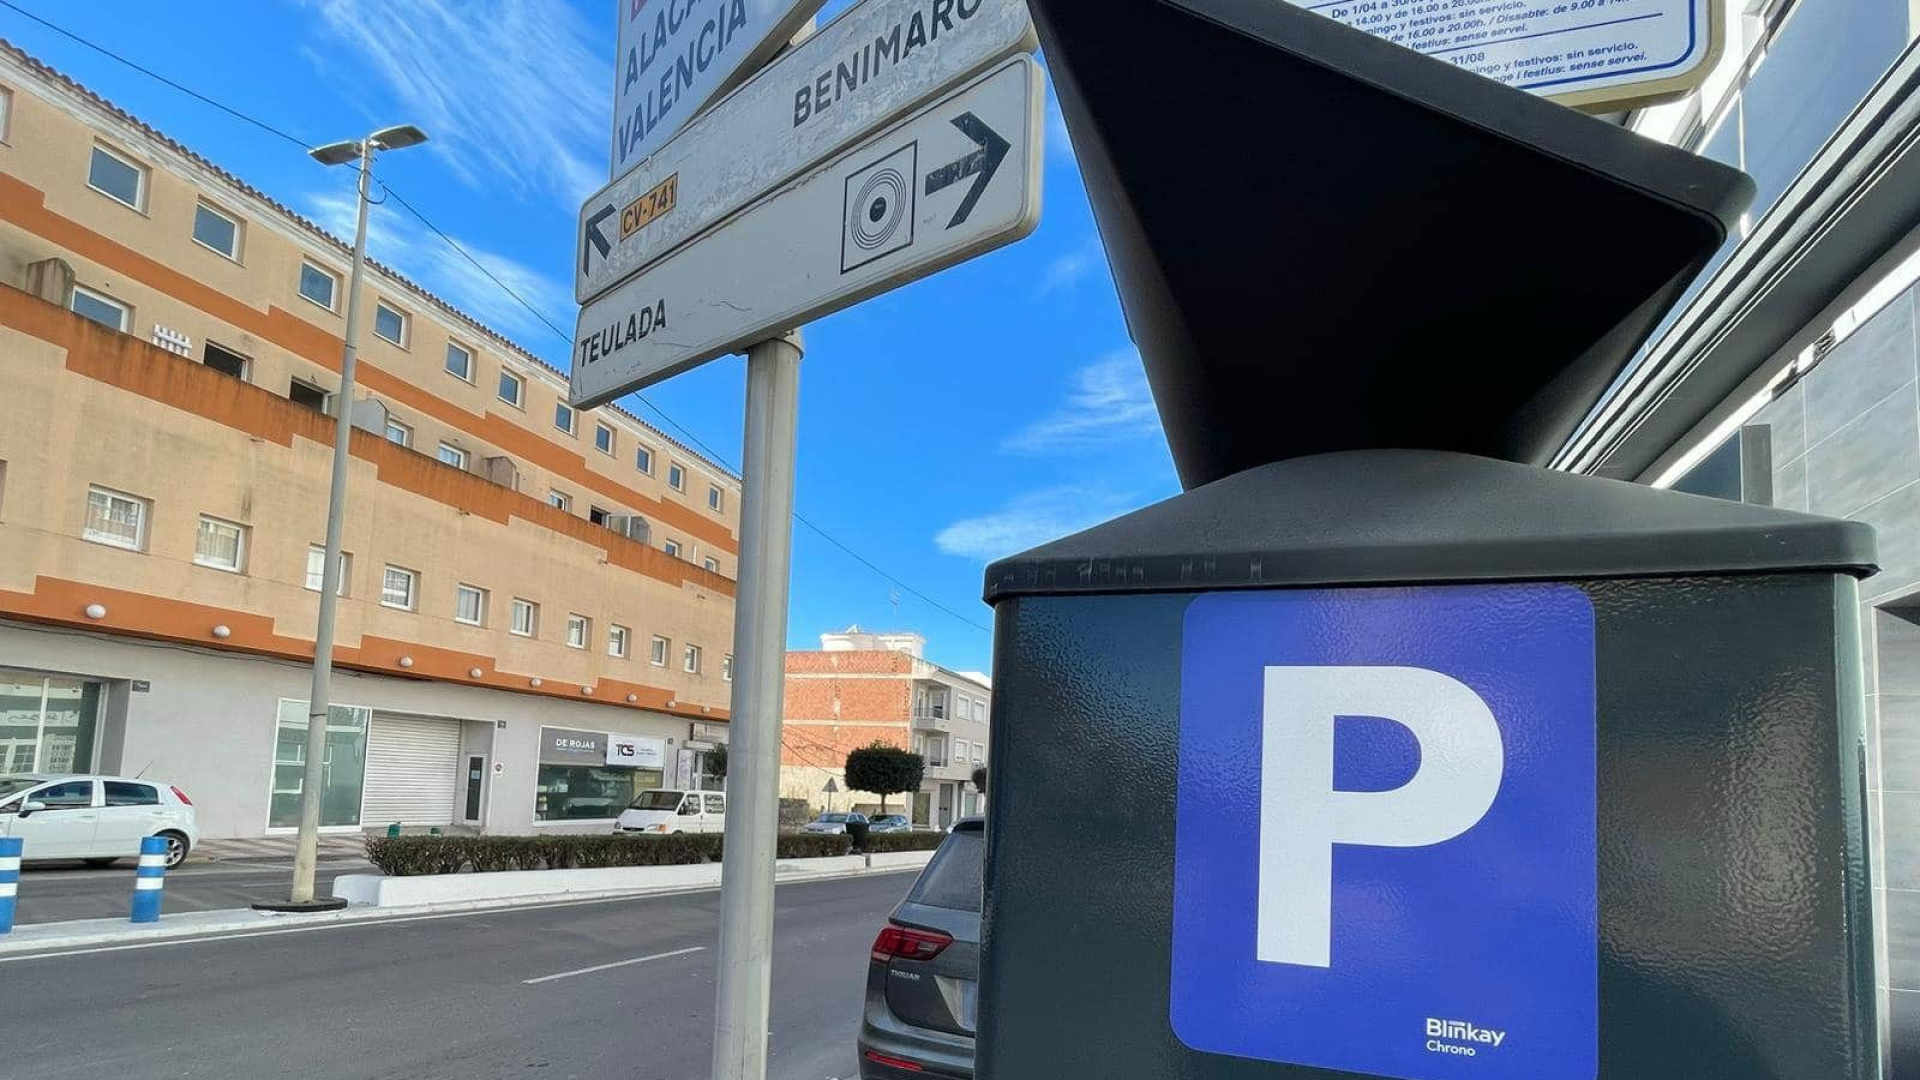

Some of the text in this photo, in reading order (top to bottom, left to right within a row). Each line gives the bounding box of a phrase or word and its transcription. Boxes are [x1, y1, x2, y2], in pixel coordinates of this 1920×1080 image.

[1332, 8, 1348, 18] De
[1353, 2, 1376, 14] 1/04
[1394, 10, 1408, 19] de
[1412, 3, 1439, 15] 16.00
[1408, 27, 1436, 40] 16.00
[1553, 5, 1567, 14] de
[1570, 0, 1595, 11] 9.00
[1458, 9, 1476, 19] sin
[1479, 1, 1526, 16] servicio.
[1455, 31, 1488, 43] sense
[1491, 23, 1528, 37] servei.
[1451, 52, 1485, 65] 31/08
[1513, 54, 1563, 68] festivos:
[1566, 50, 1584, 60] sin
[1588, 41, 1638, 57] servicio.
[1523, 64, 1566, 79] festius:
[1570, 60, 1605, 71] sense
[1607, 51, 1647, 66] servei.
[618, 0, 747, 164] VALENCIA
[622, 180, 675, 235] CV-741
[580, 298, 667, 367] TEULADA
[556, 738, 595, 750] DE ROJAS
[615, 743, 635, 757] TCS
[1256, 665, 1503, 968] P
[1426, 1017, 1506, 1047] Blinkay
[1426, 1040, 1476, 1057] Chrono
